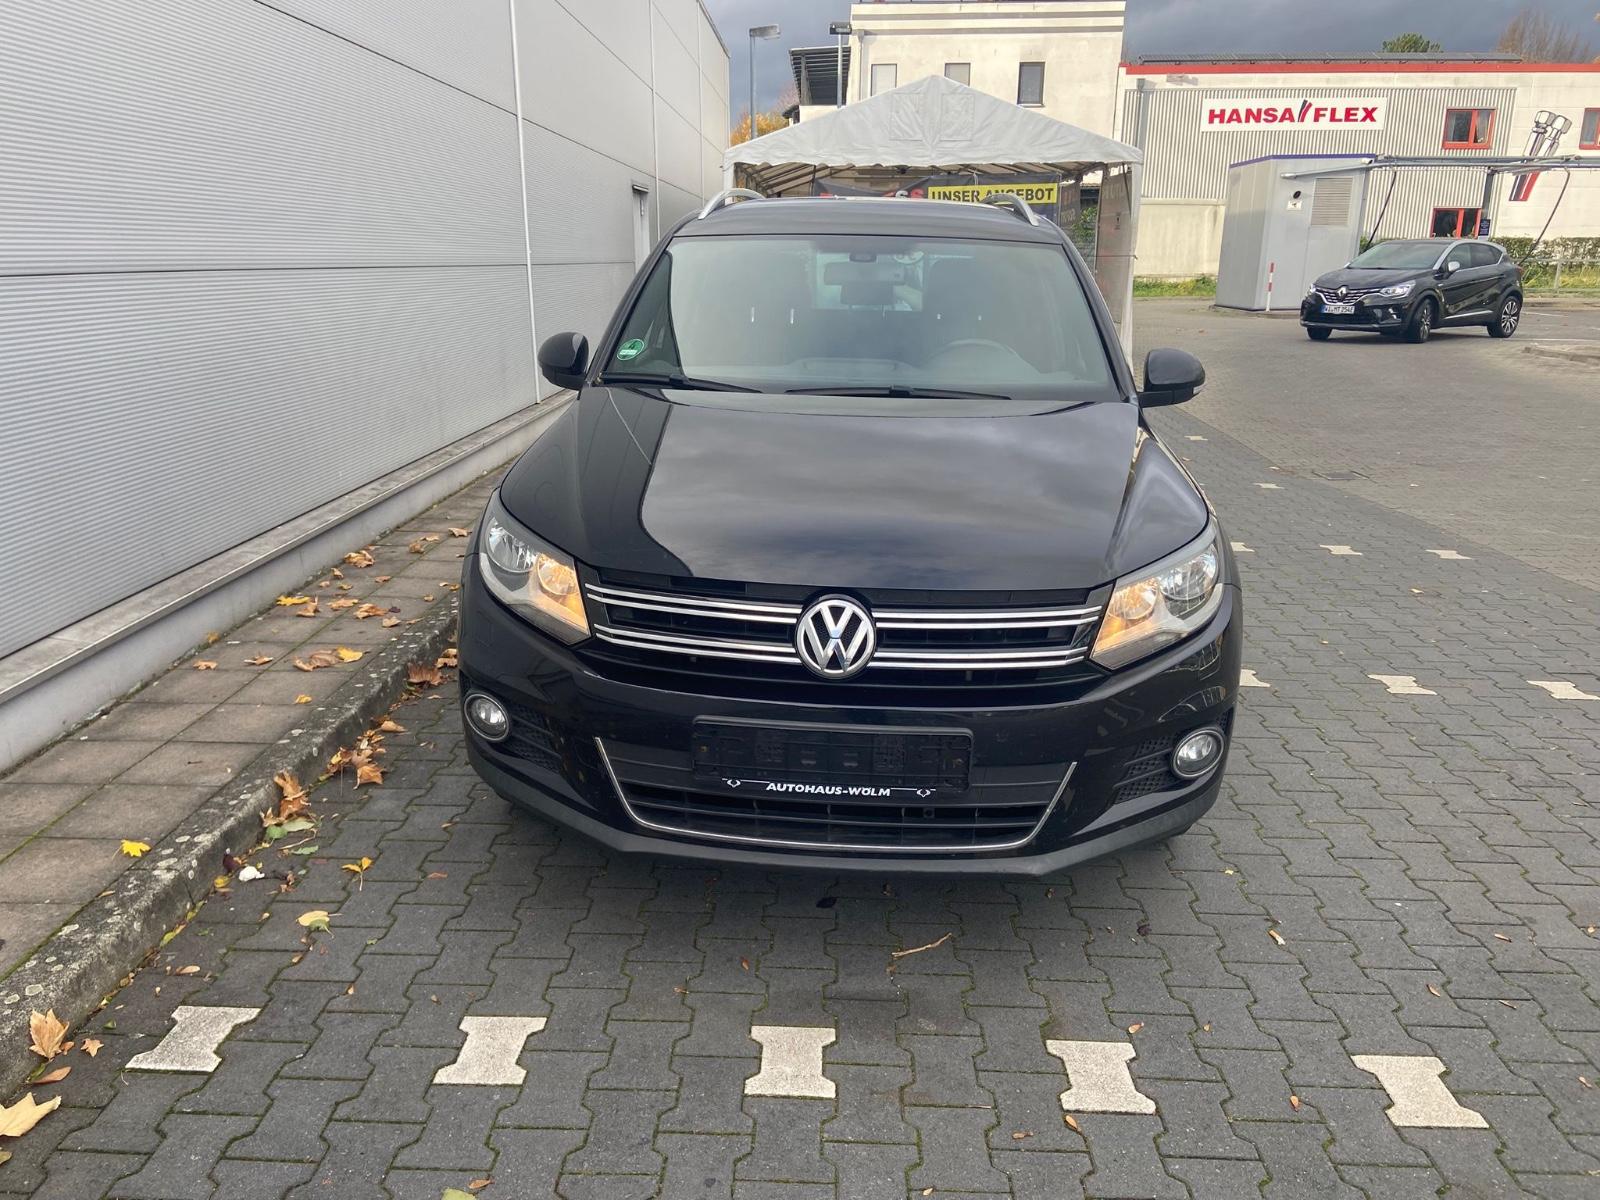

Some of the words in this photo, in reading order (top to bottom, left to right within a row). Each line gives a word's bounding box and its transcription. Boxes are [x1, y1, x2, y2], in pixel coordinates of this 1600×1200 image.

[1208, 107, 1295, 124] HANSA
[1313, 106, 1379, 123] FLEX
[931, 190, 980, 202] UNSER
[985, 188, 1053, 201] AEBOT
[797, 601, 873, 675] VW
[766, 782, 891, 797] AUTOHAUS-WÖLM
